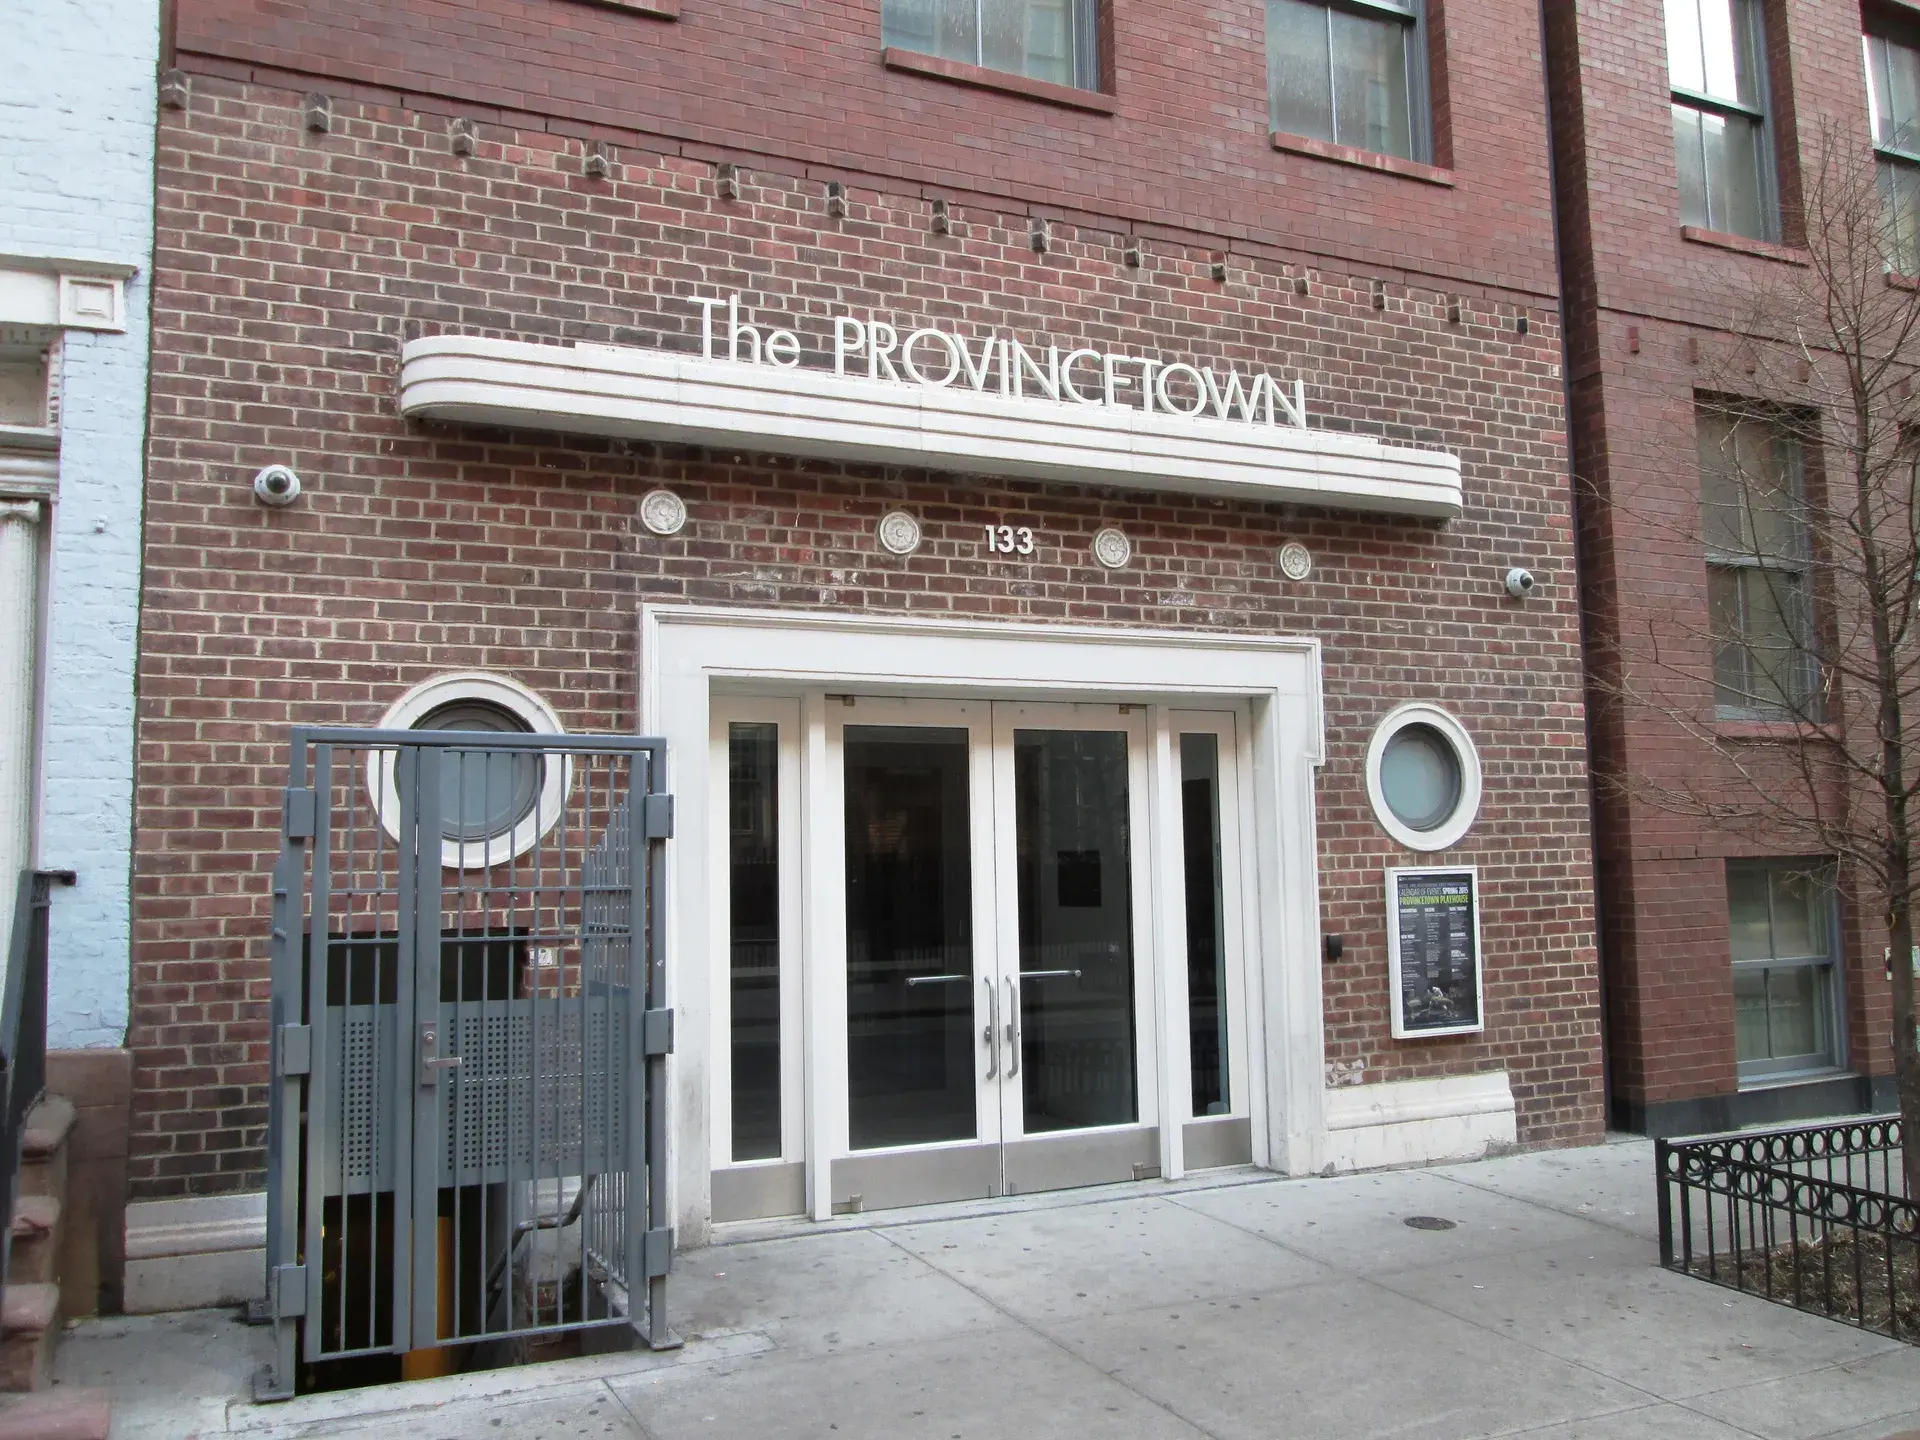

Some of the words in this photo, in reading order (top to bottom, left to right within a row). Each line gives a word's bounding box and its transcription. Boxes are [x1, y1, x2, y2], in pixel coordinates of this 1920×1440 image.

[687, 294, 801, 369] The
[834, 315, 1307, 431] PROVINCETOWN
[985, 524, 1034, 554] 133
[1399, 896, 1439, 905] PROVINCETOWN
[1440, 895, 1468, 904] PLAYHOUSE
